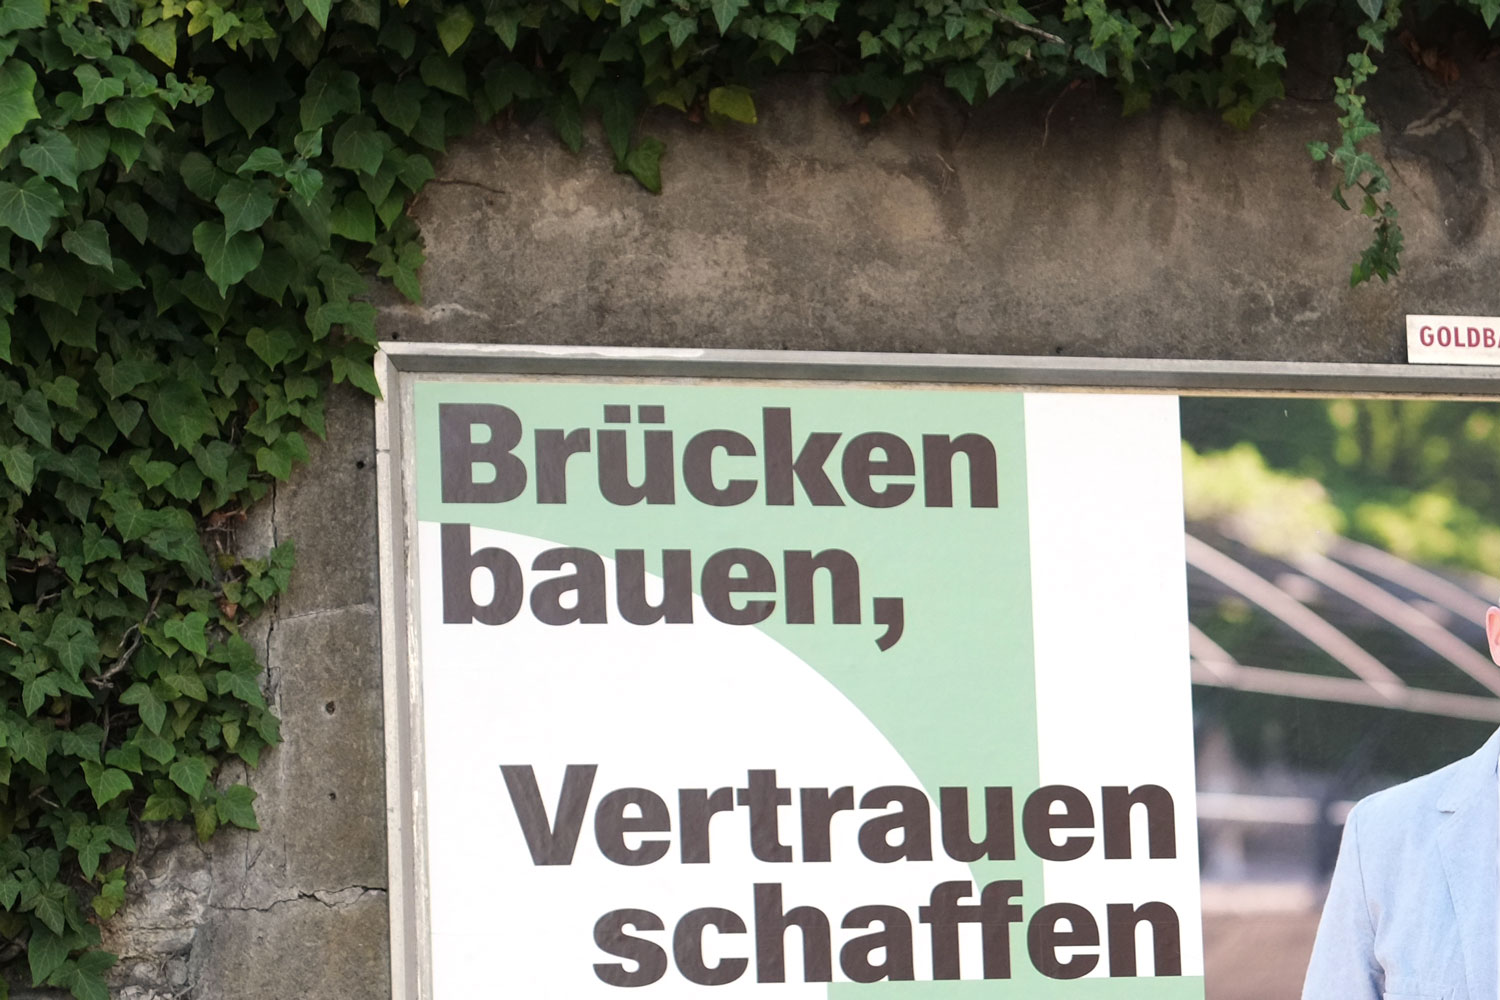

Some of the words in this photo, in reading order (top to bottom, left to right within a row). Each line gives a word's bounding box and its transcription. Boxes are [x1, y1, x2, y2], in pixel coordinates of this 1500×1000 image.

[438, 402, 1000, 509] Brücken
[440, 522, 905, 653] bauen,
[500, 763, 1178, 867] Vertrauen
[591, 879, 1183, 988] schaffen
